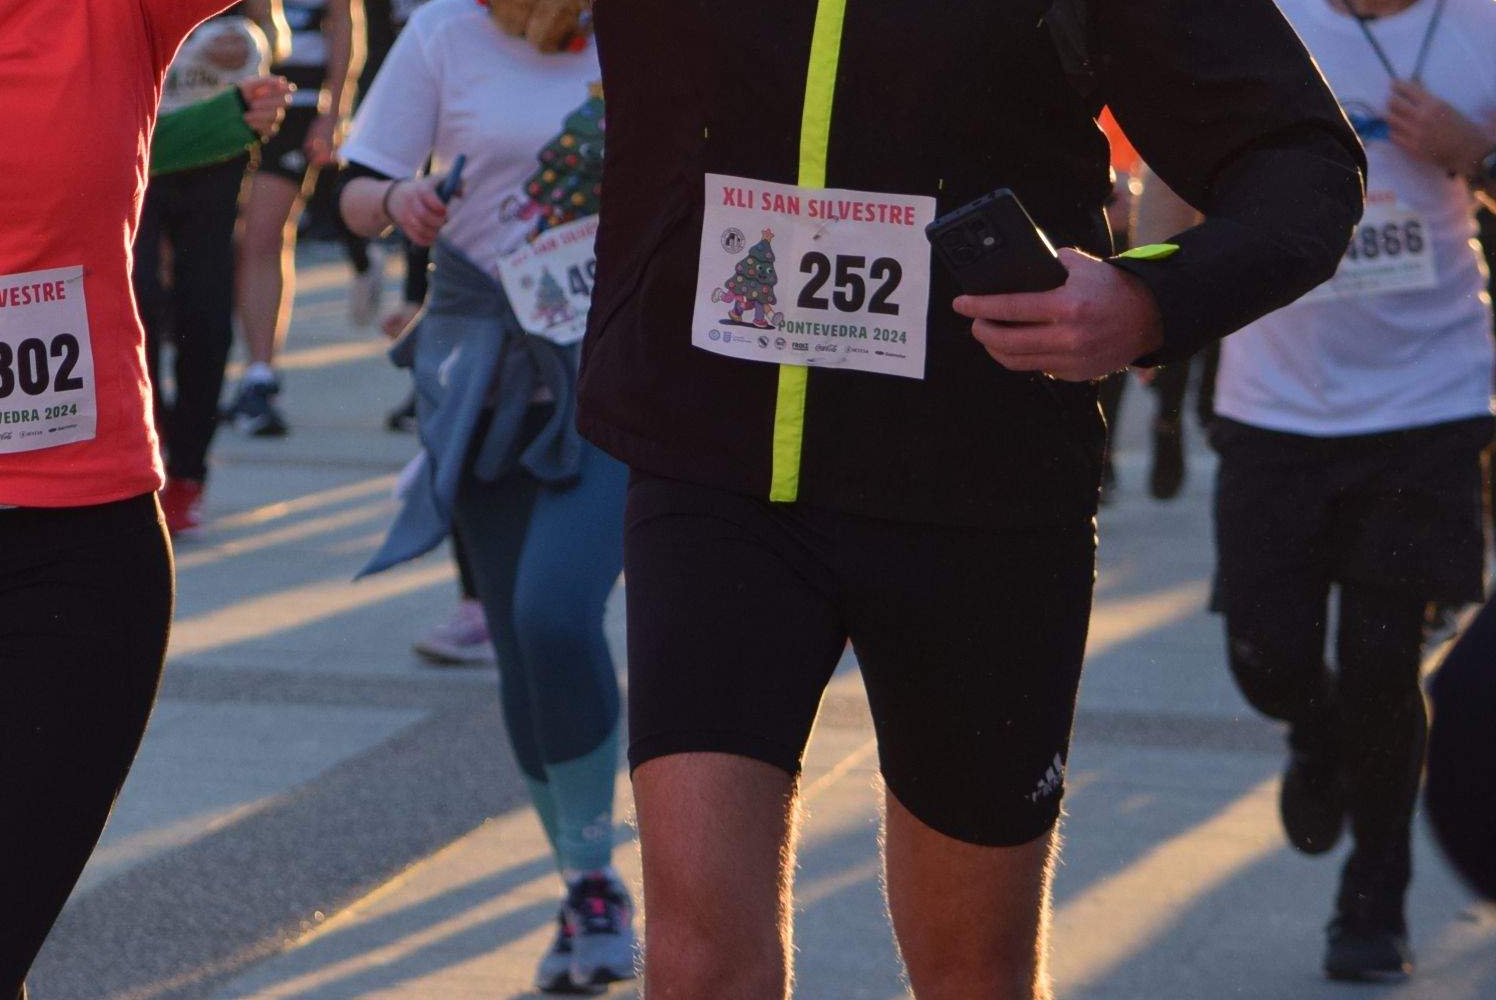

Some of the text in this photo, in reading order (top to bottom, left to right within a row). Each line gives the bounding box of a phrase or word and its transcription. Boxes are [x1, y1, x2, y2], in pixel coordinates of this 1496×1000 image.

[722, 186, 915, 226] XLI SAN SILVESTRE
[797, 250, 903, 316] 252
[777, 320, 907, 344] PONTEVEDRA 2024
[45, 403, 77, 421] 2024
